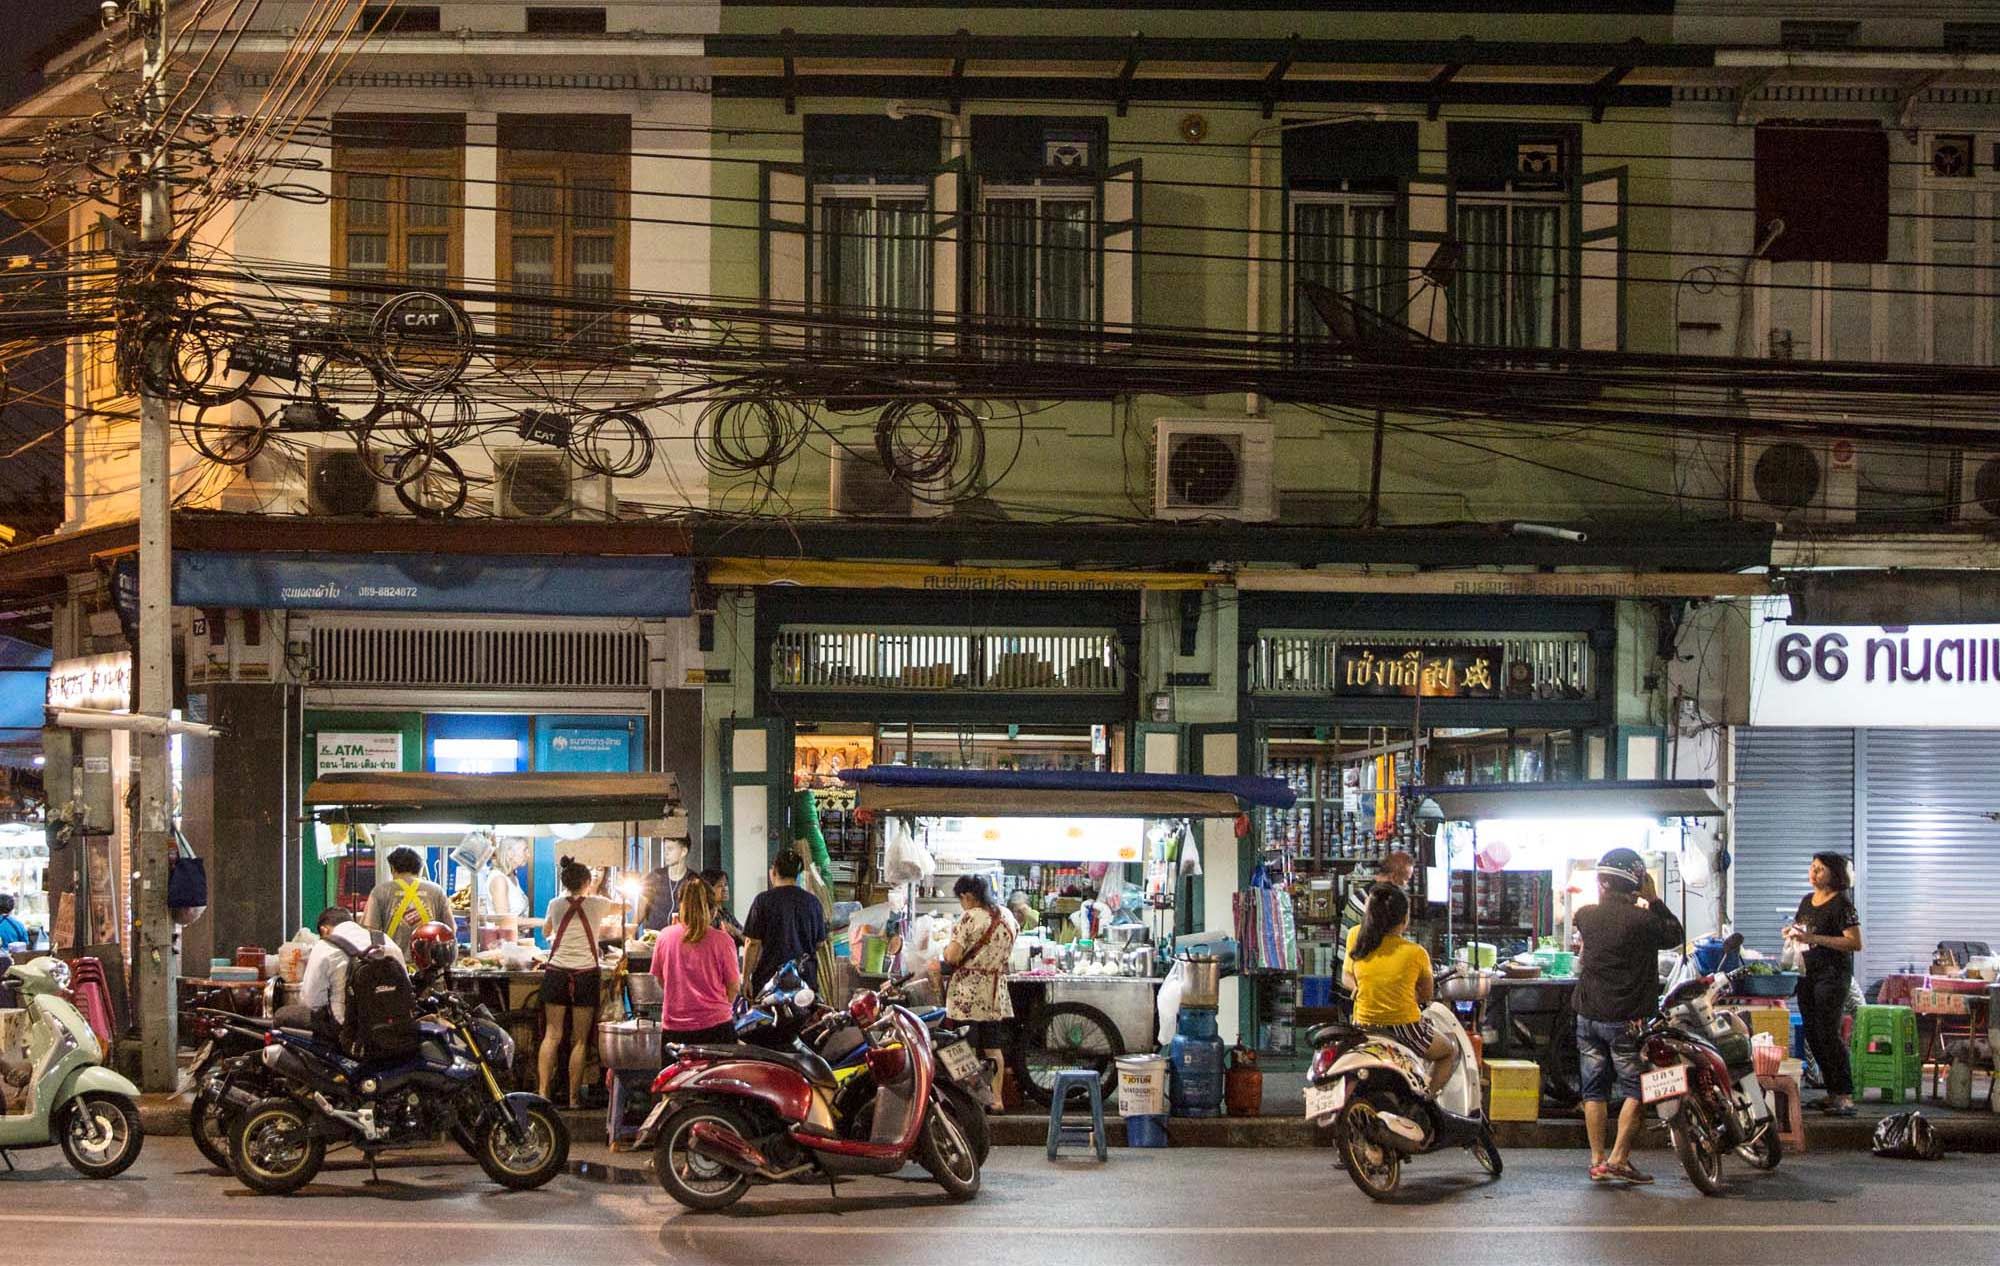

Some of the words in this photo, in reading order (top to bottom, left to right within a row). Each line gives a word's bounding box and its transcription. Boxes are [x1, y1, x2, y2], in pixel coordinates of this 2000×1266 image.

[405, 313, 439, 326] CAT
[534, 430, 556, 441] CAT
[195, 620, 204, 634] 72
[1777, 632, 1849, 682] 66
[335, 745, 364, 756] ATM
